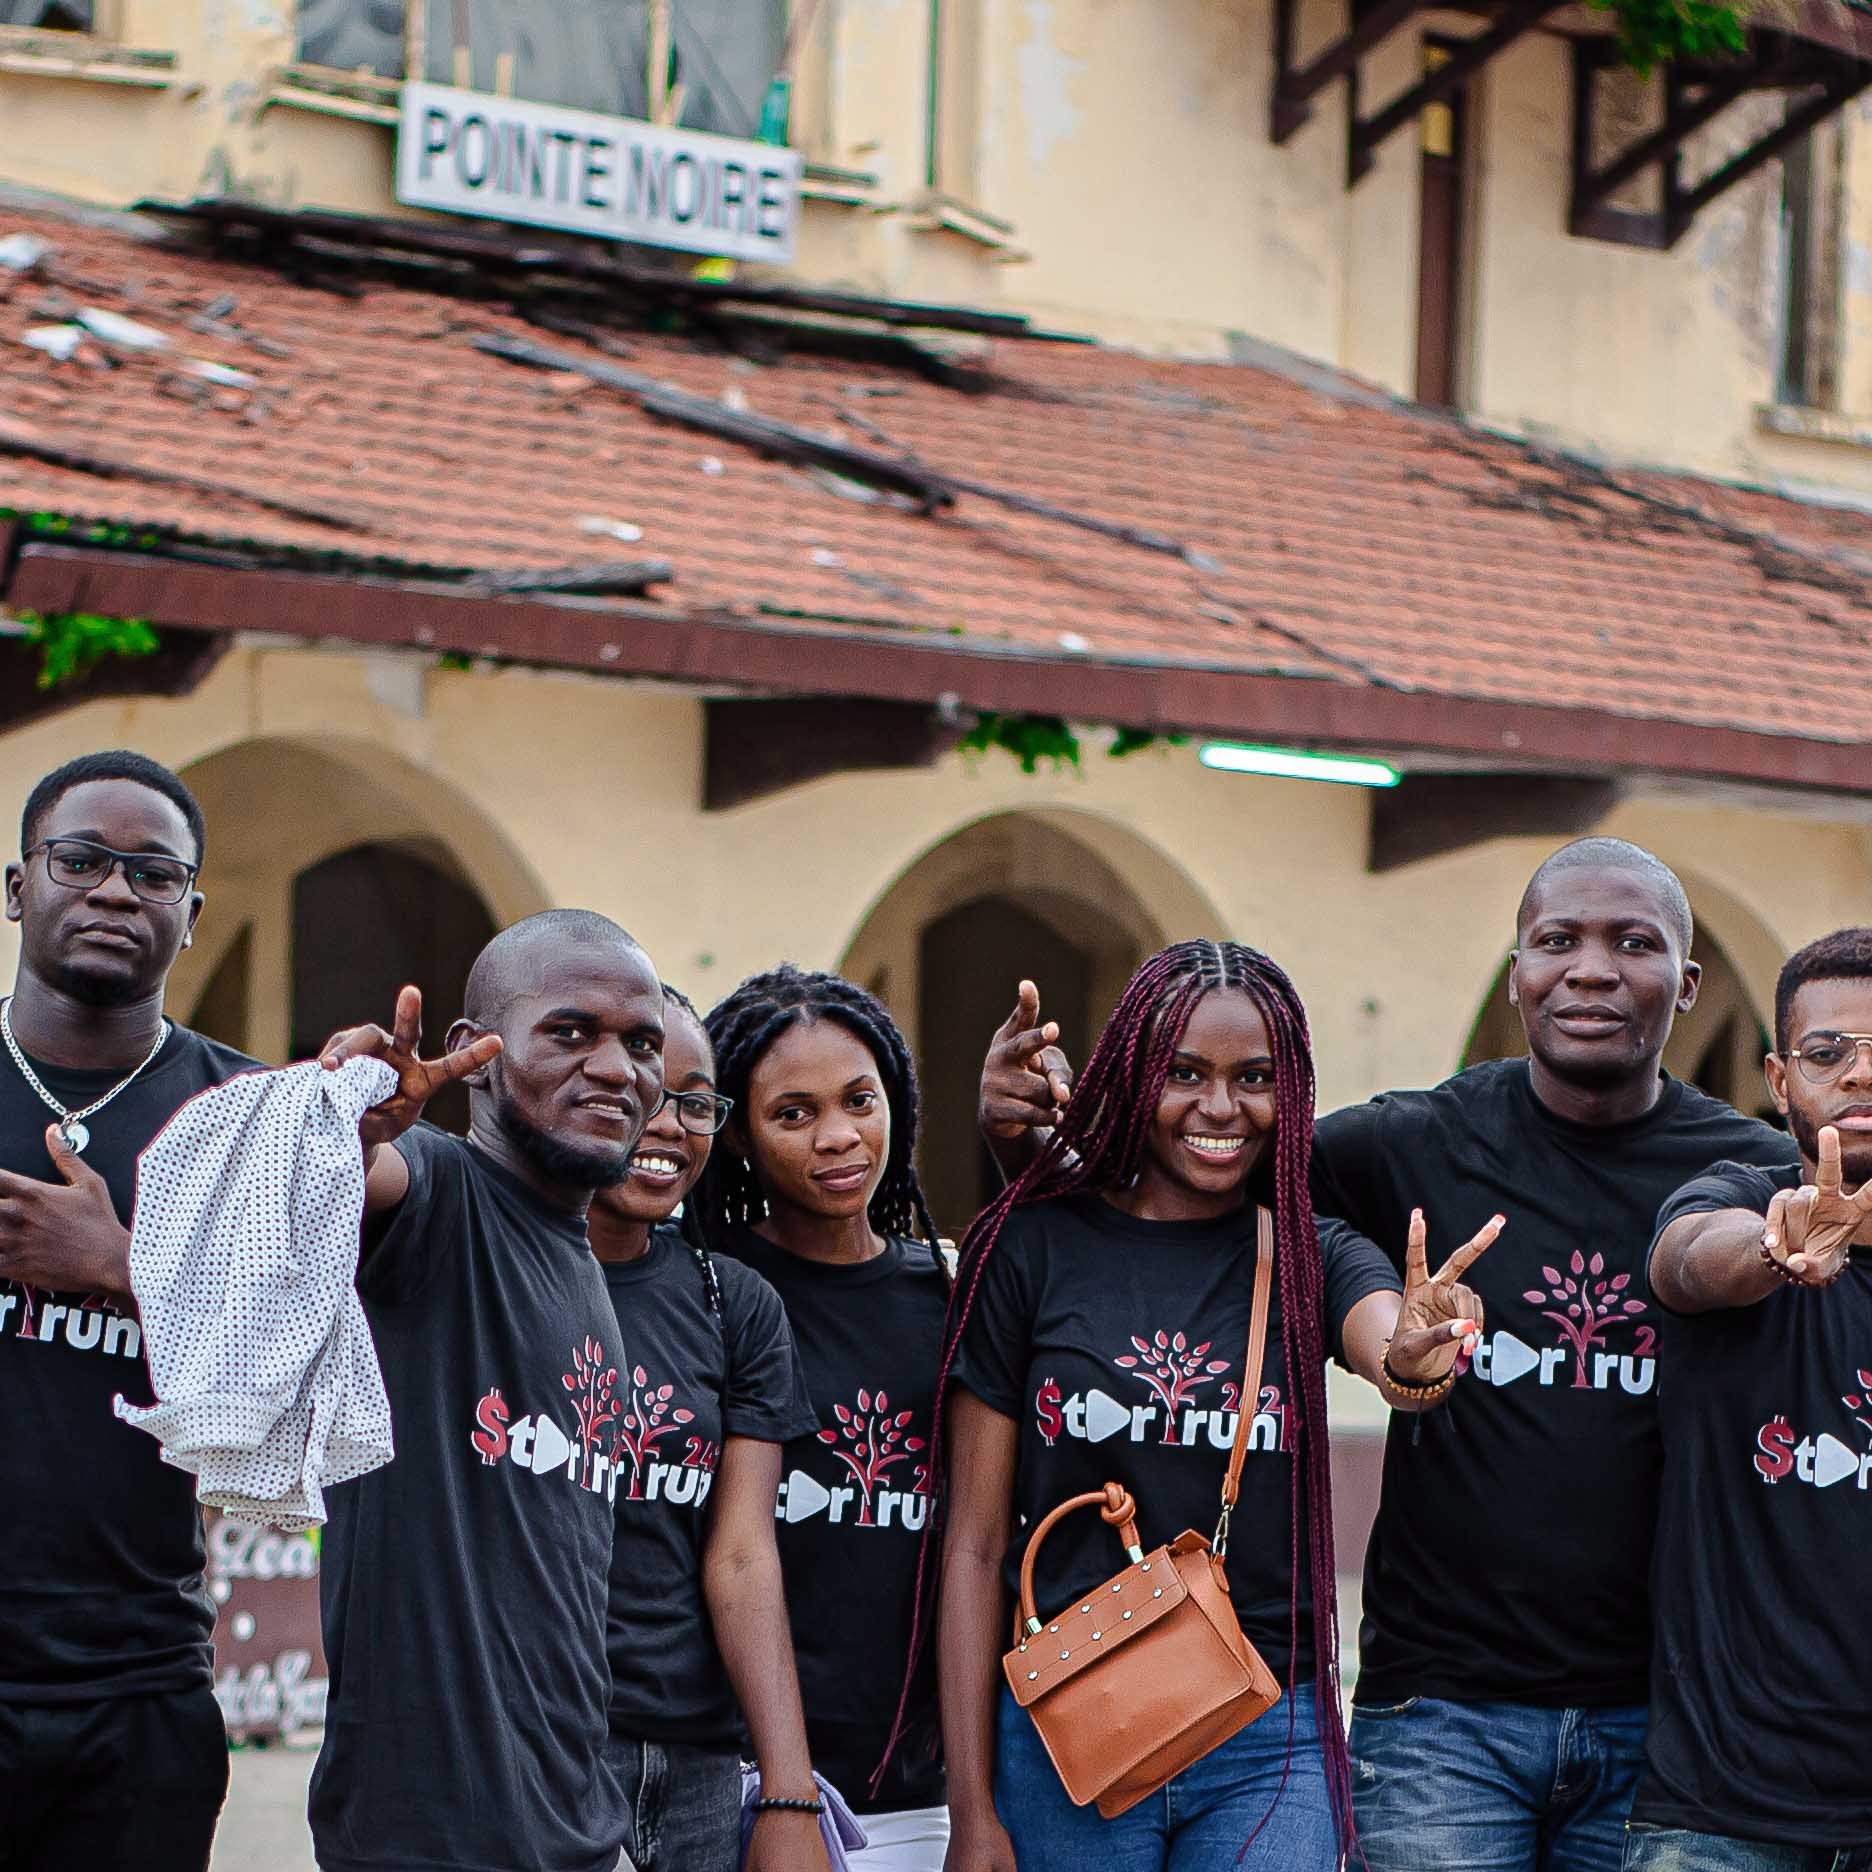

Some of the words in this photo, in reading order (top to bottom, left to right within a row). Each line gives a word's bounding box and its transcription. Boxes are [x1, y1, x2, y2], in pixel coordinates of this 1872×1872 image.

[417, 107, 610, 208] POINTE
[627, 144, 783, 239] NOIRE
[1221, 1382, 1281, 1414] 22
[681, 1435, 720, 1473] 24
